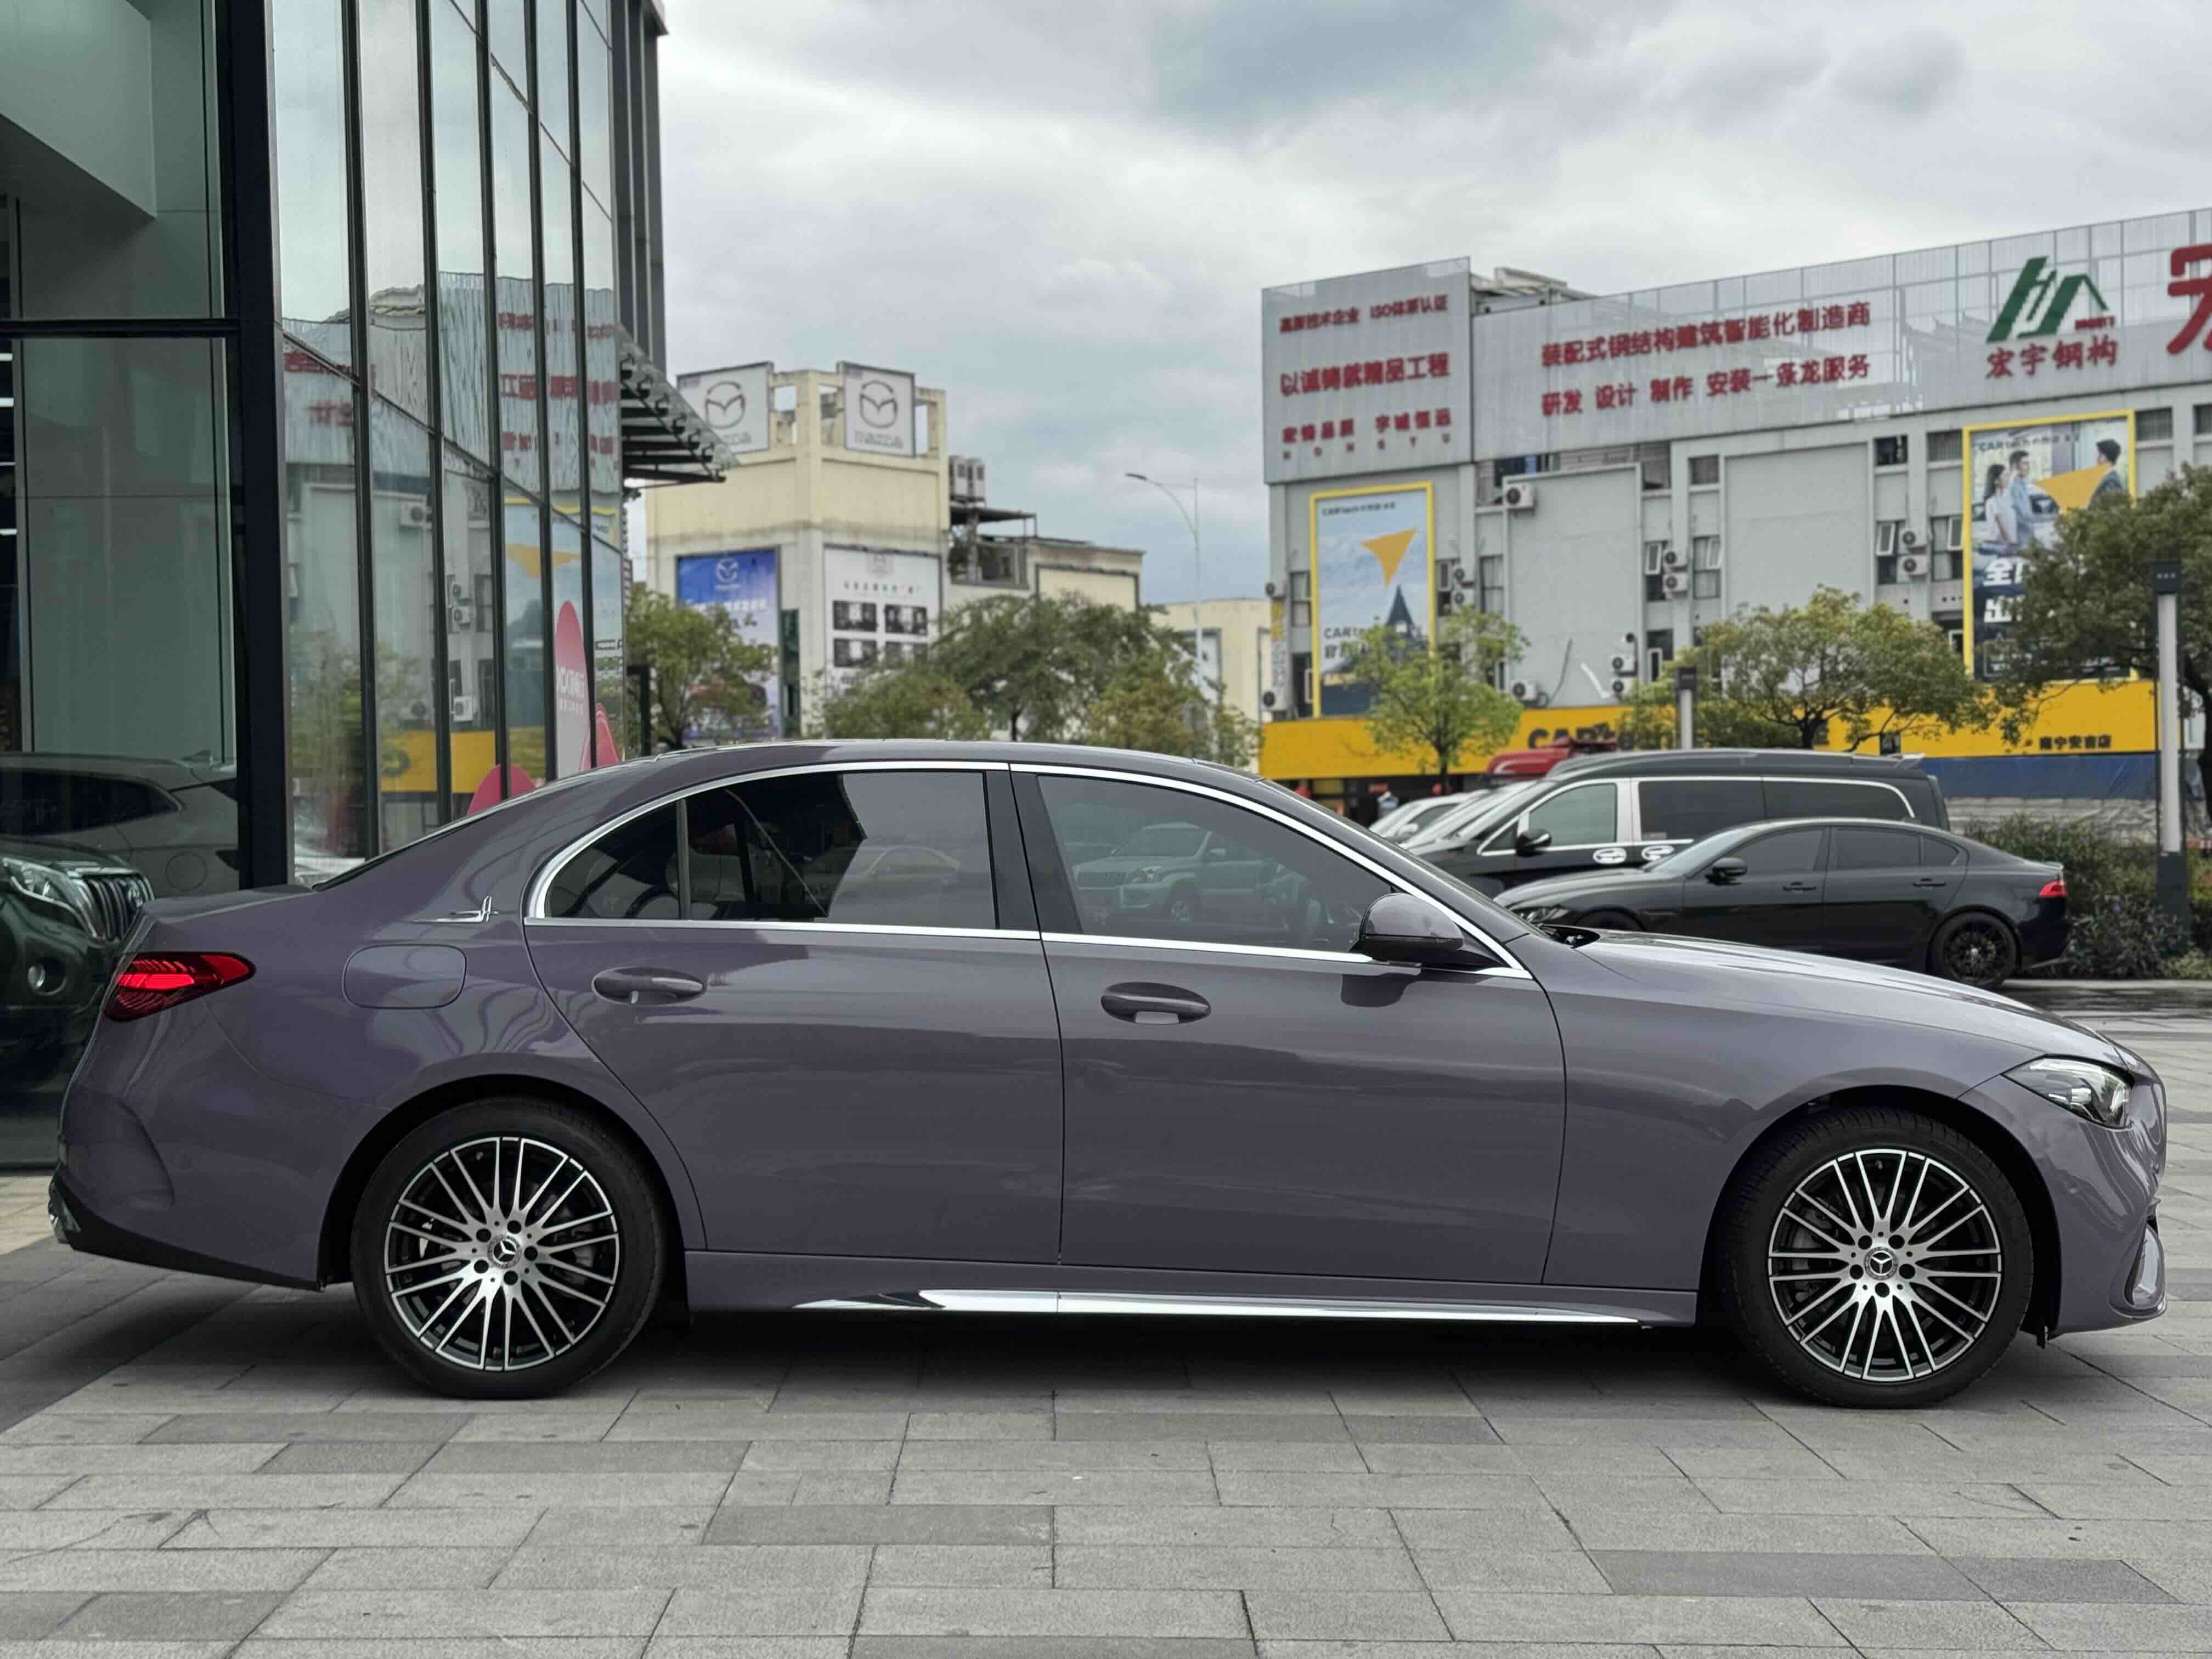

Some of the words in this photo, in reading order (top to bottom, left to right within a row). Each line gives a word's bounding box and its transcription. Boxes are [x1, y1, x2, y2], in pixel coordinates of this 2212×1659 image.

[1541, 388, 1582, 417] 研发
[1595, 383, 1637, 411] 设计
[1650, 376, 1694, 403] 制作
[1706, 354, 1870, 397] 安装一条龙服务
